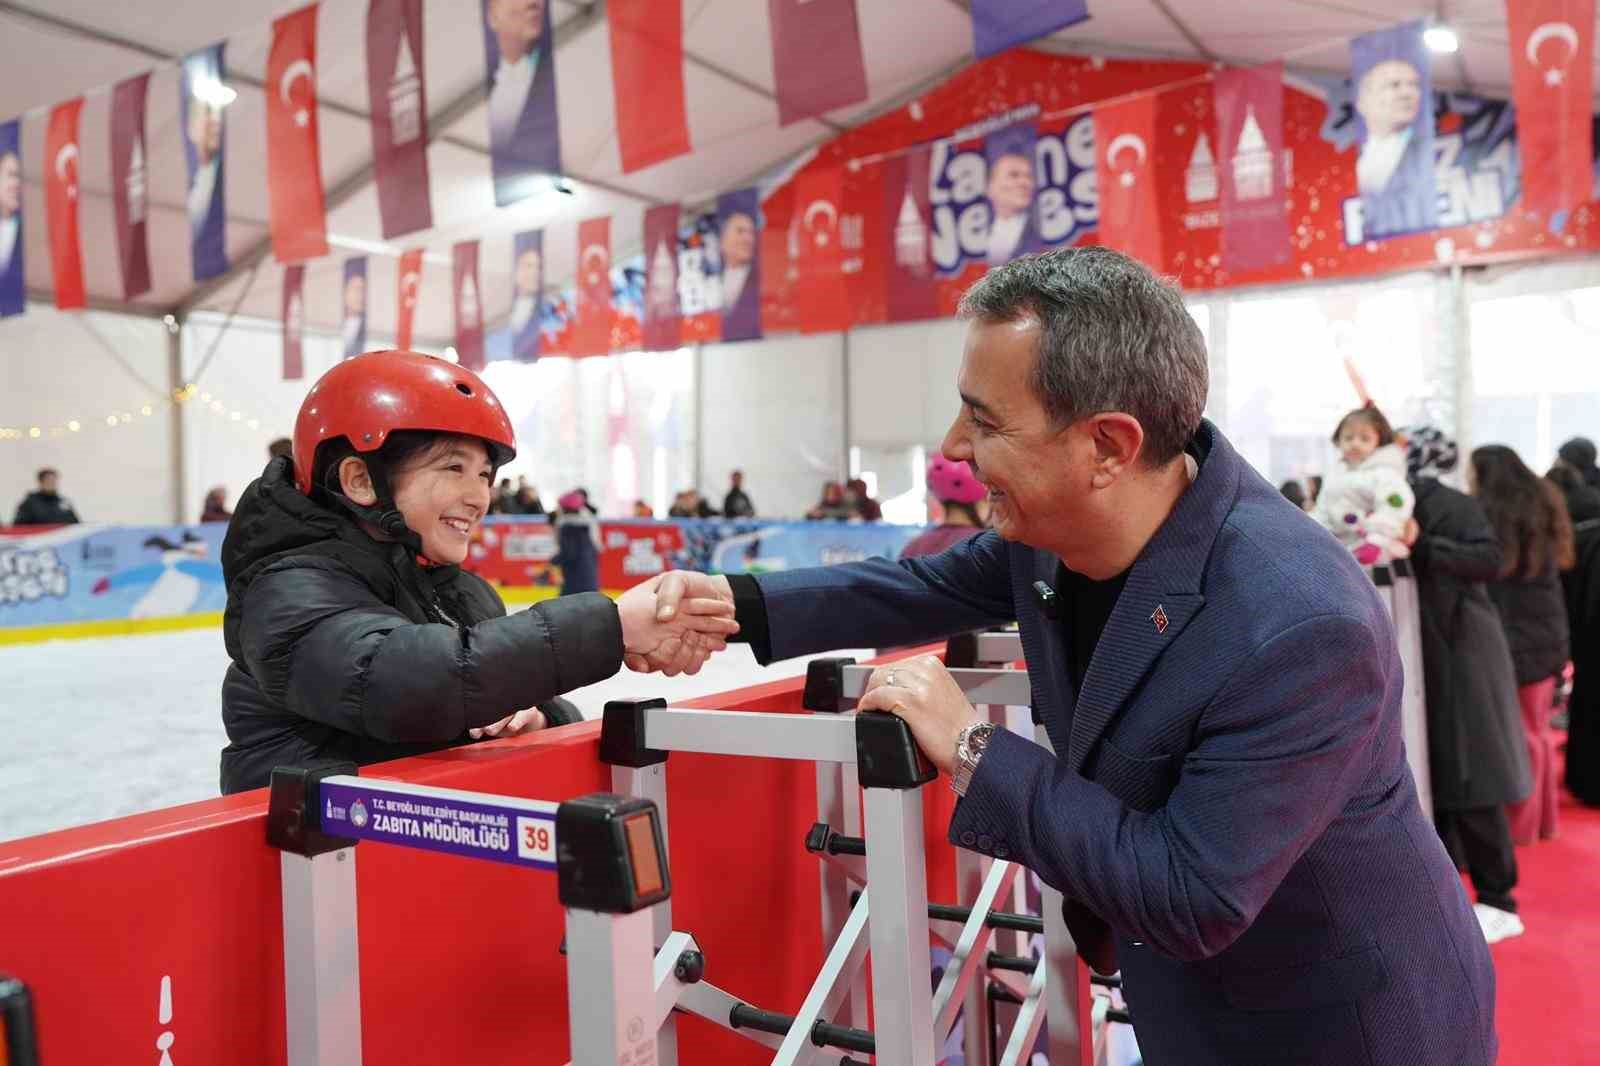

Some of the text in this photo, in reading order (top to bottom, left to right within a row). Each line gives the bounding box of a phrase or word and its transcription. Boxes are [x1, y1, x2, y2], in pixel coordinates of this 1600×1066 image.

[372, 798, 509, 828] T.C. BEYOĞLU BELEDİYE BAŞKANLIĞI
[373, 814, 510, 852] ZABITA MÜDÜRLÜĞÜ
[525, 826, 549, 852] 39
